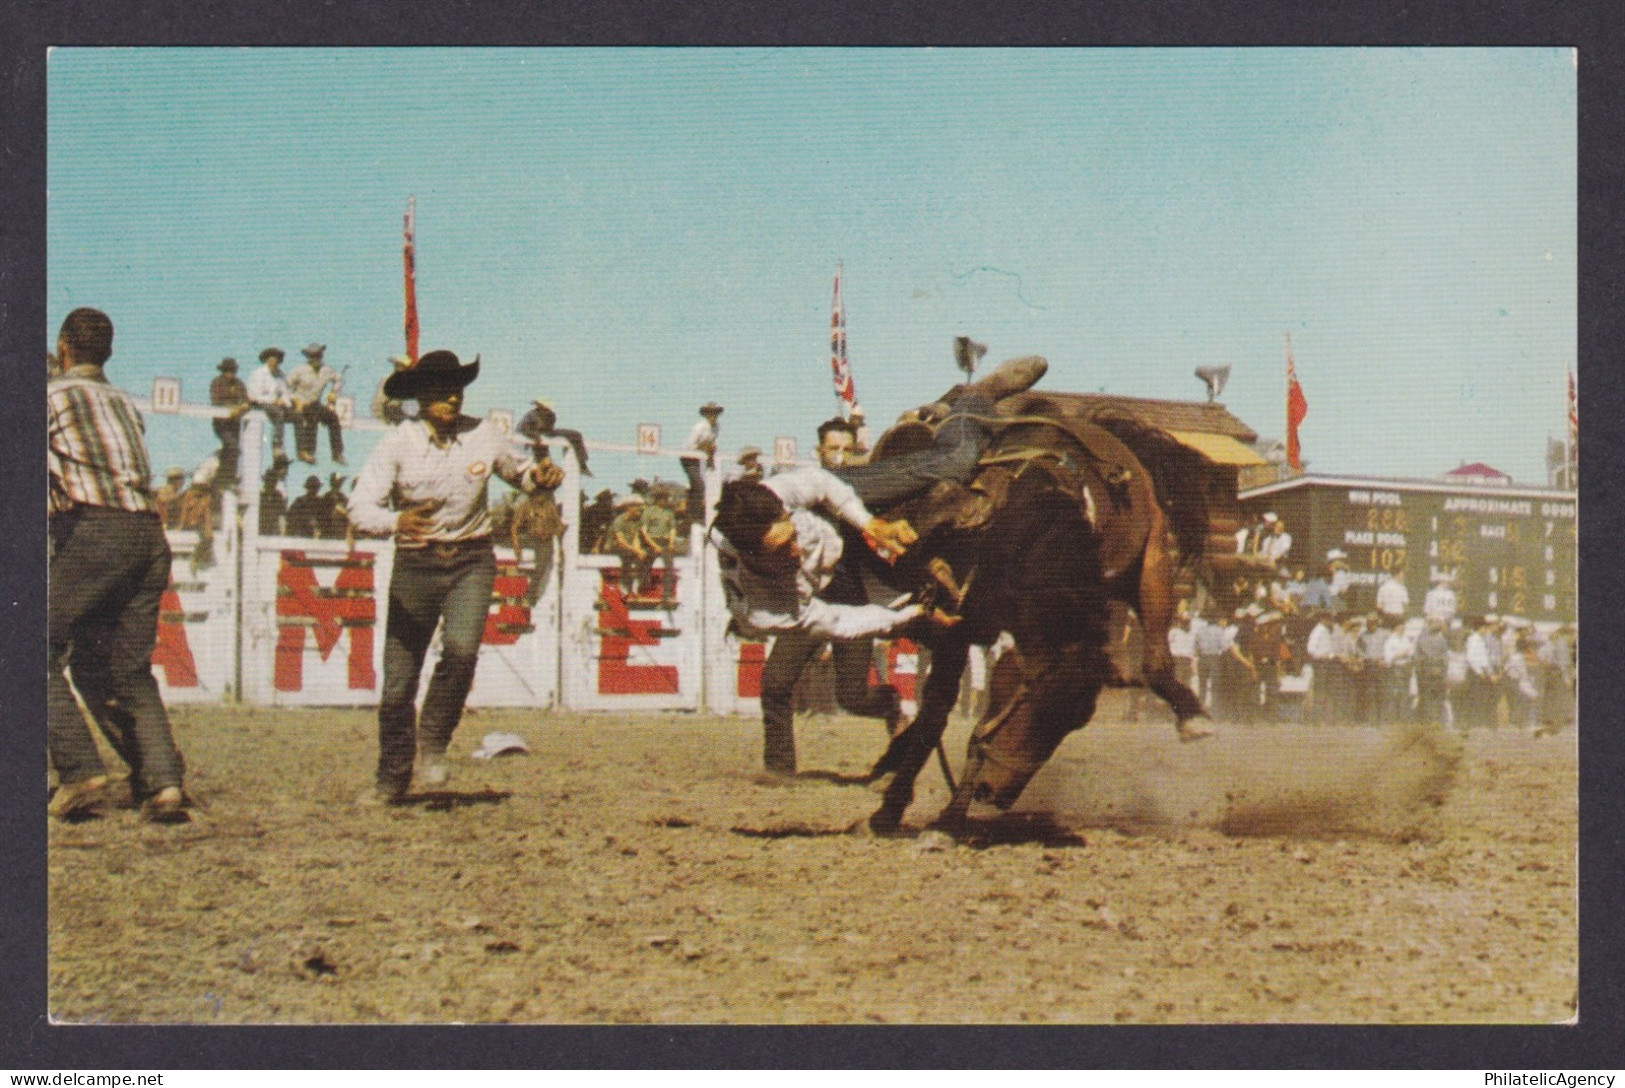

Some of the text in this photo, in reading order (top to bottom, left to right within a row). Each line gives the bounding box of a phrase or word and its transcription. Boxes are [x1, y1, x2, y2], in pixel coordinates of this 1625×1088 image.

[1373, 491, 1402, 506] POOL
[1444, 498, 1532, 515] APPROXIMATE
[1376, 532, 1407, 547] POOL
